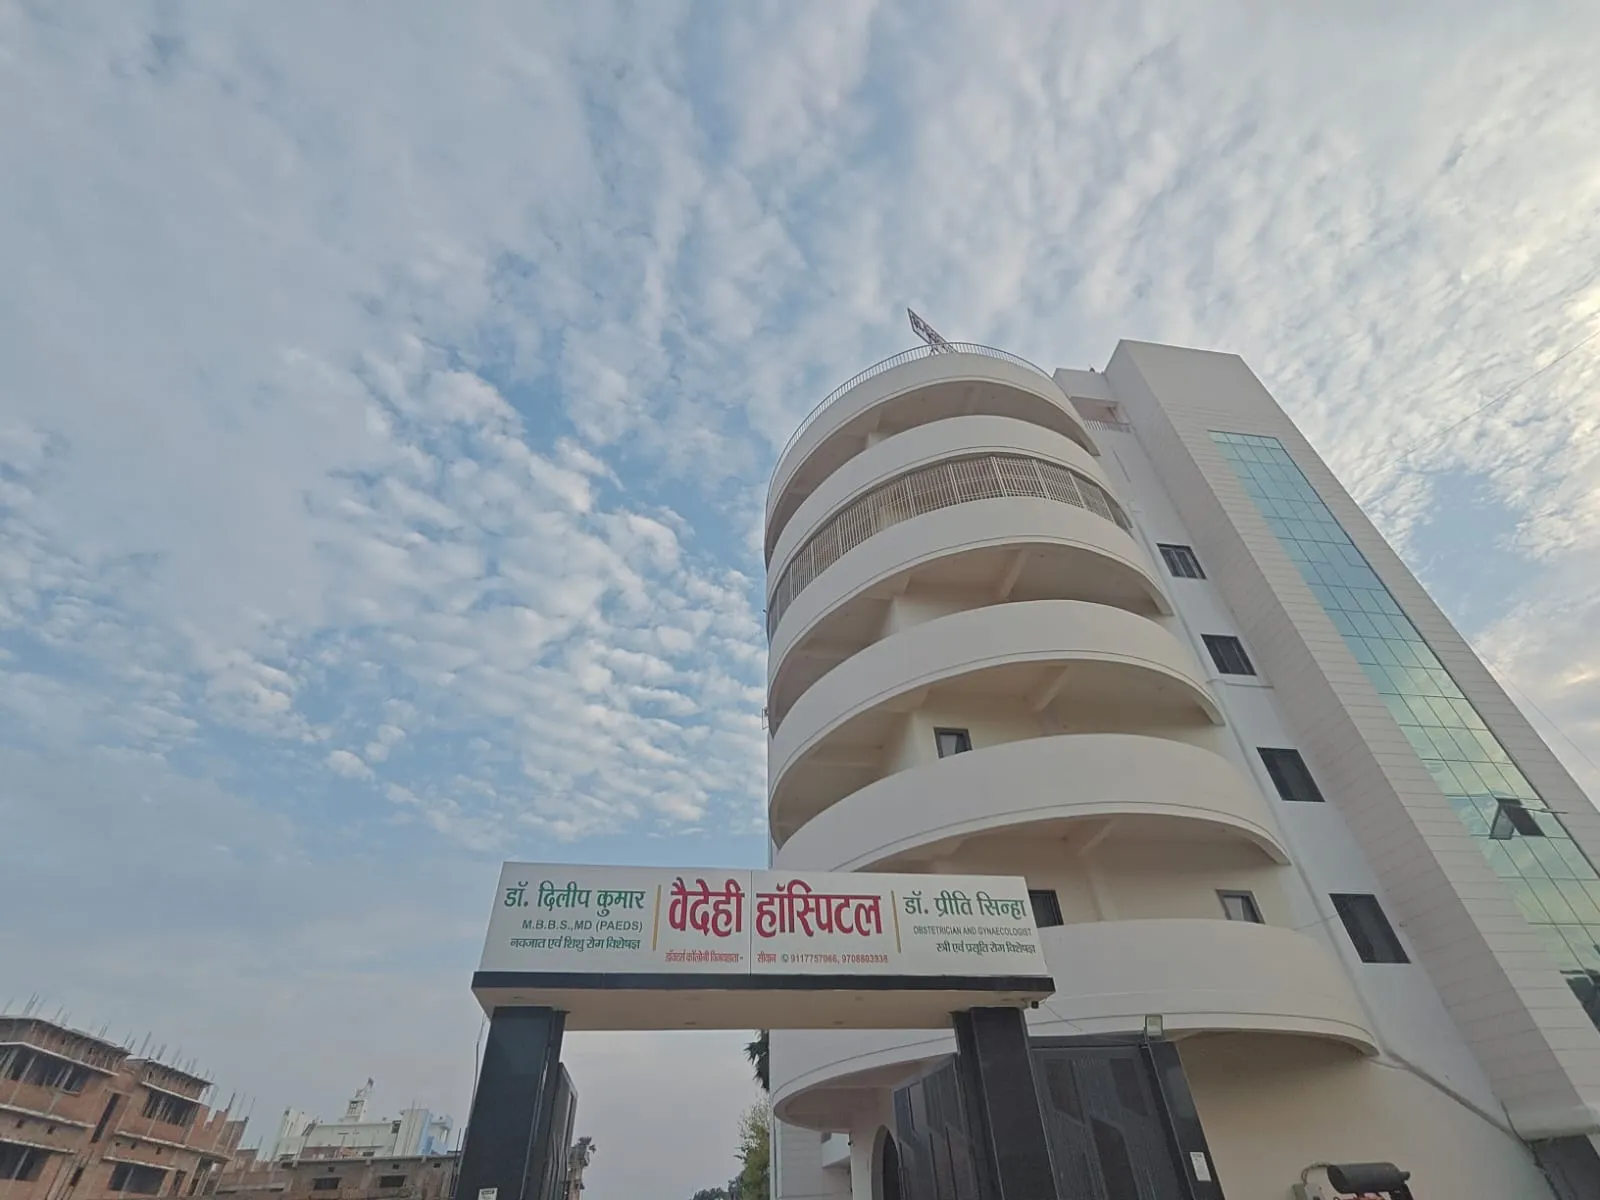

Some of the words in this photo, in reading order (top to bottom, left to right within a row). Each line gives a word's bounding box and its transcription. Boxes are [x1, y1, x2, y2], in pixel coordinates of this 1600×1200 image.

[504, 880, 529, 908] डॉ.
[537, 880, 593, 912] दिलीप
[596, 889, 646, 917] कुमार
[668, 876, 745, 937] वैदेही
[755, 879, 883, 938] हॉस्पिटल
[902, 890, 930, 915] डॉ.
[933, 890, 974, 917] प्रीति
[975, 891, 1027, 920] सिन्हा
[595, 920, 643, 933] (PAEDS)
[913, 925, 961, 936] OBSTETRICIAN
[963, 926, 977, 936] AND
[978, 927, 1032, 937] GYNAECOLOGIST
[510, 937, 546, 949] नवजात
[547, 935, 564, 949] एवं
[564, 936, 584, 952] शिशु
[586, 936, 604, 950] रोग
[605, 935, 641, 950] विशेषज्ञ
[990, 941, 1006, 953] रोग
